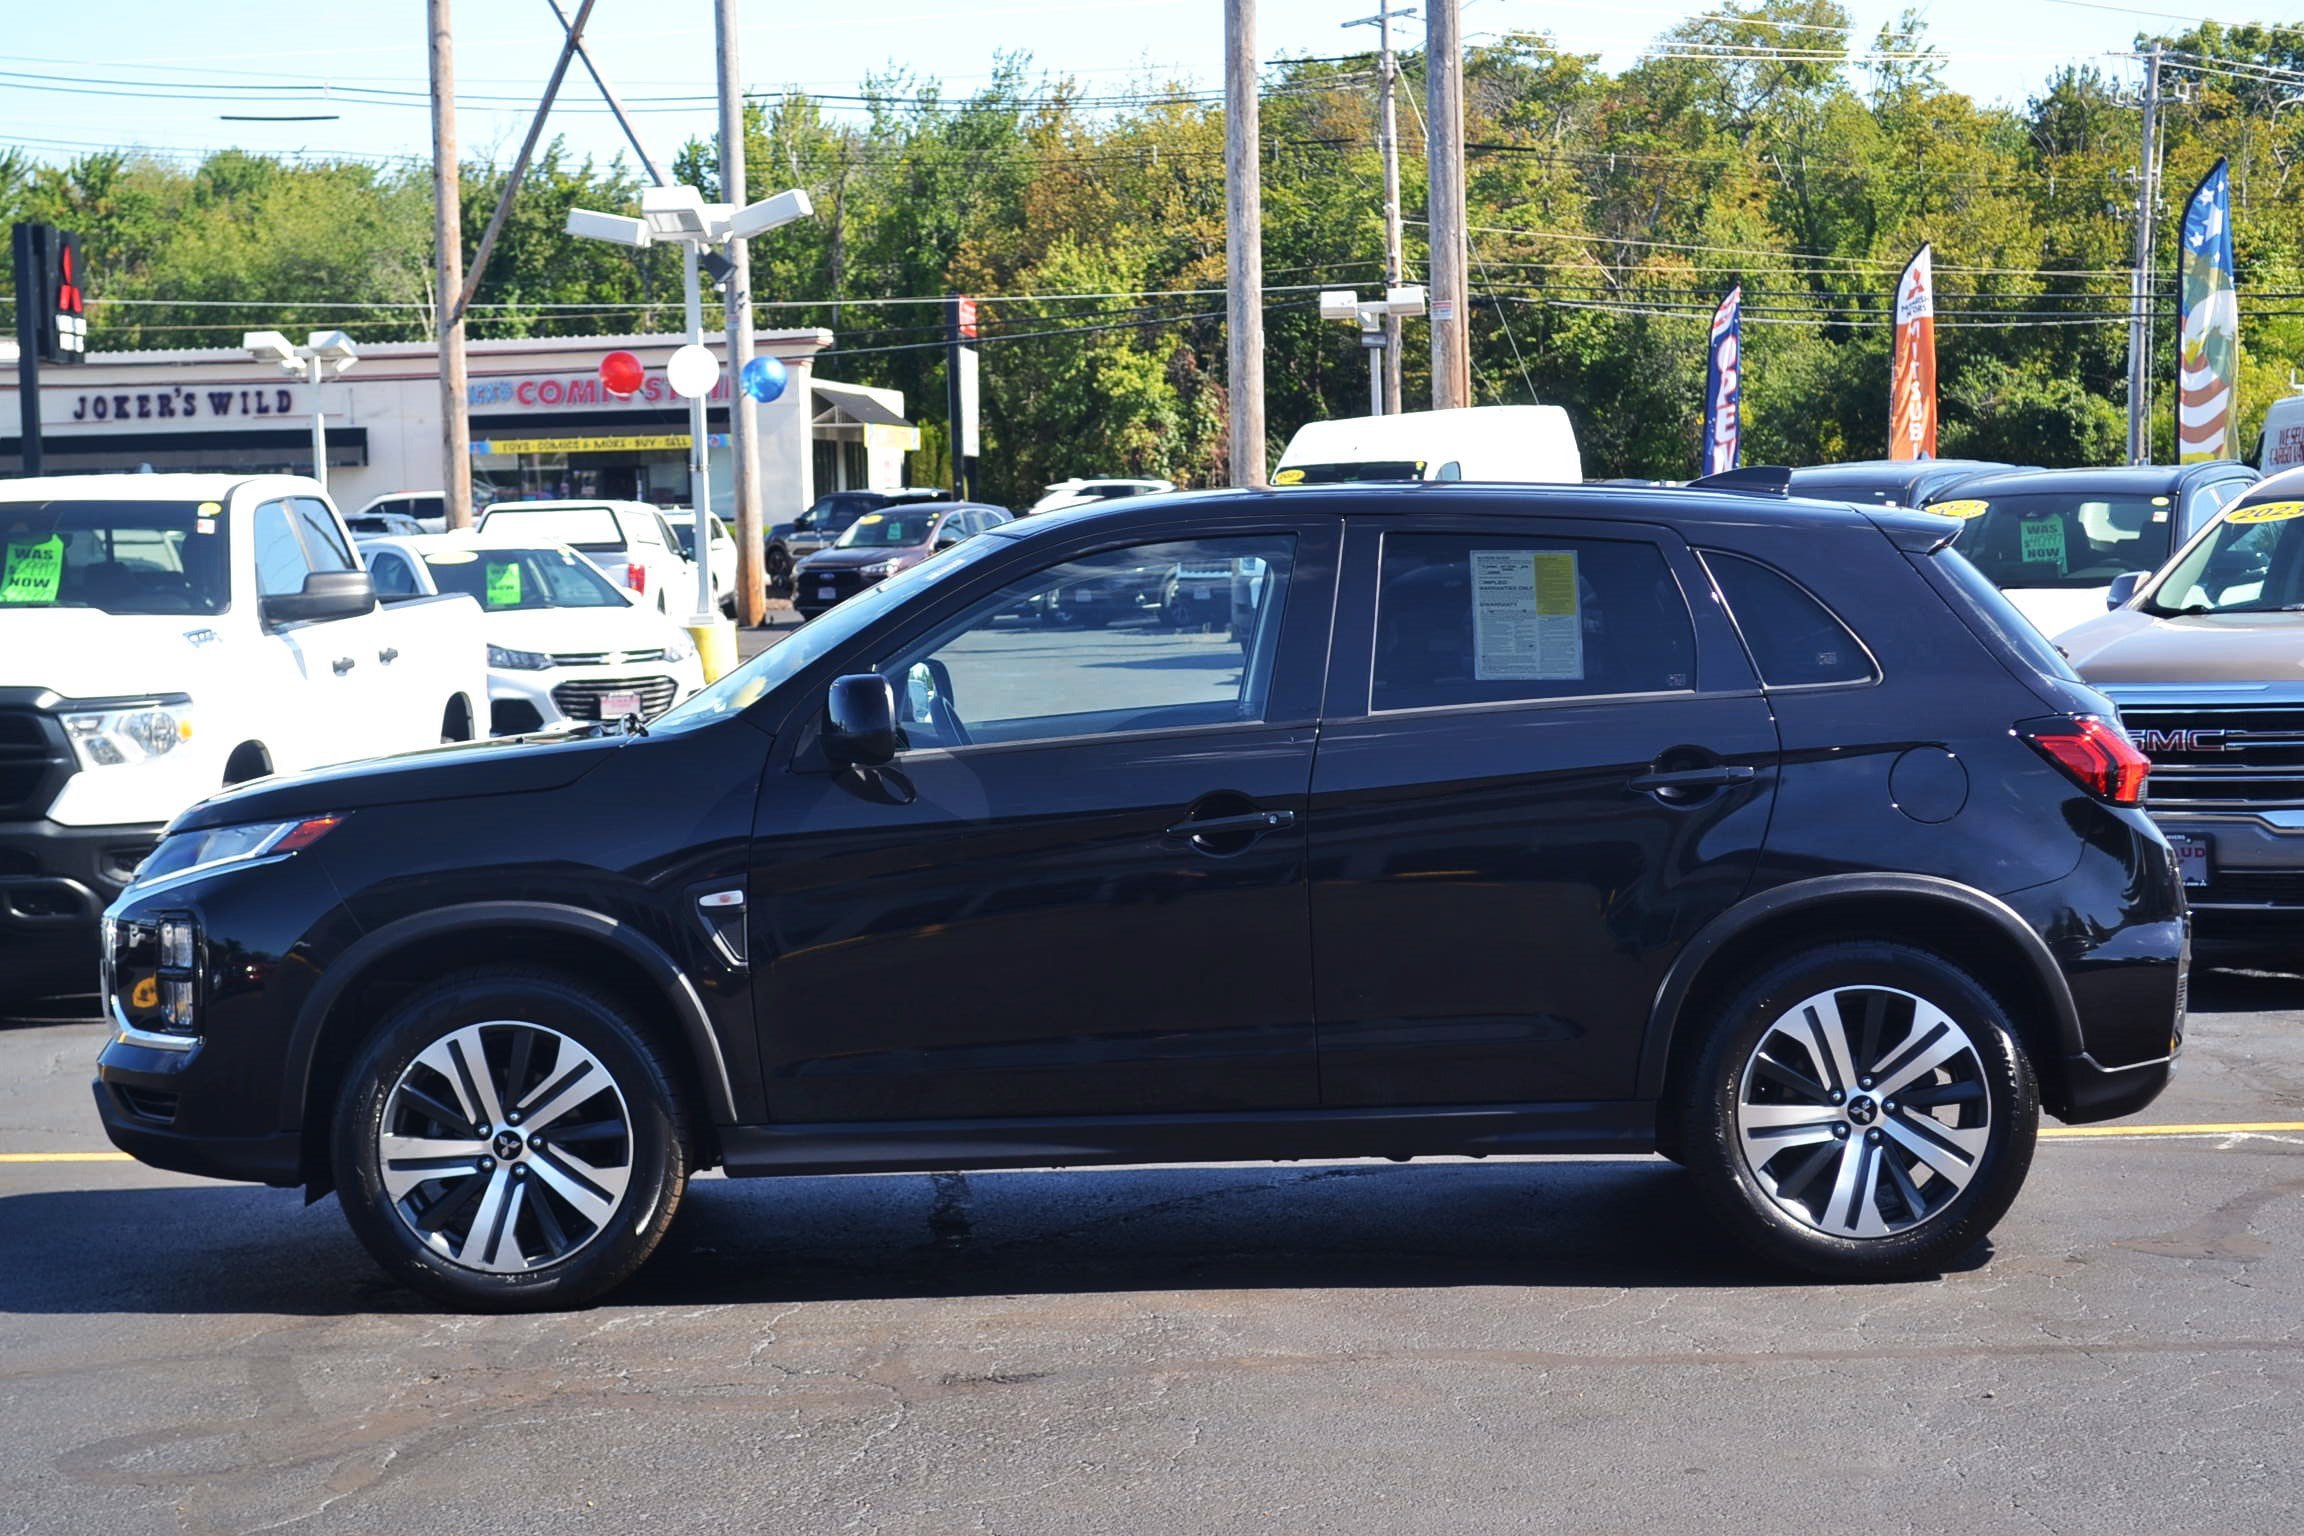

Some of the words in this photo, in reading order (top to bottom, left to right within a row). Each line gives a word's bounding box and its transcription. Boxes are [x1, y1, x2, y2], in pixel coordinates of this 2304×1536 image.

[73, 387, 197, 420] JOKER'S
[208, 389, 293, 416] WILD
[2027, 524, 2058, 534] WAS
[15, 549, 53, 559] WAS
[2028, 548, 2059, 558] NOW
[9, 577, 50, 588] NOW
